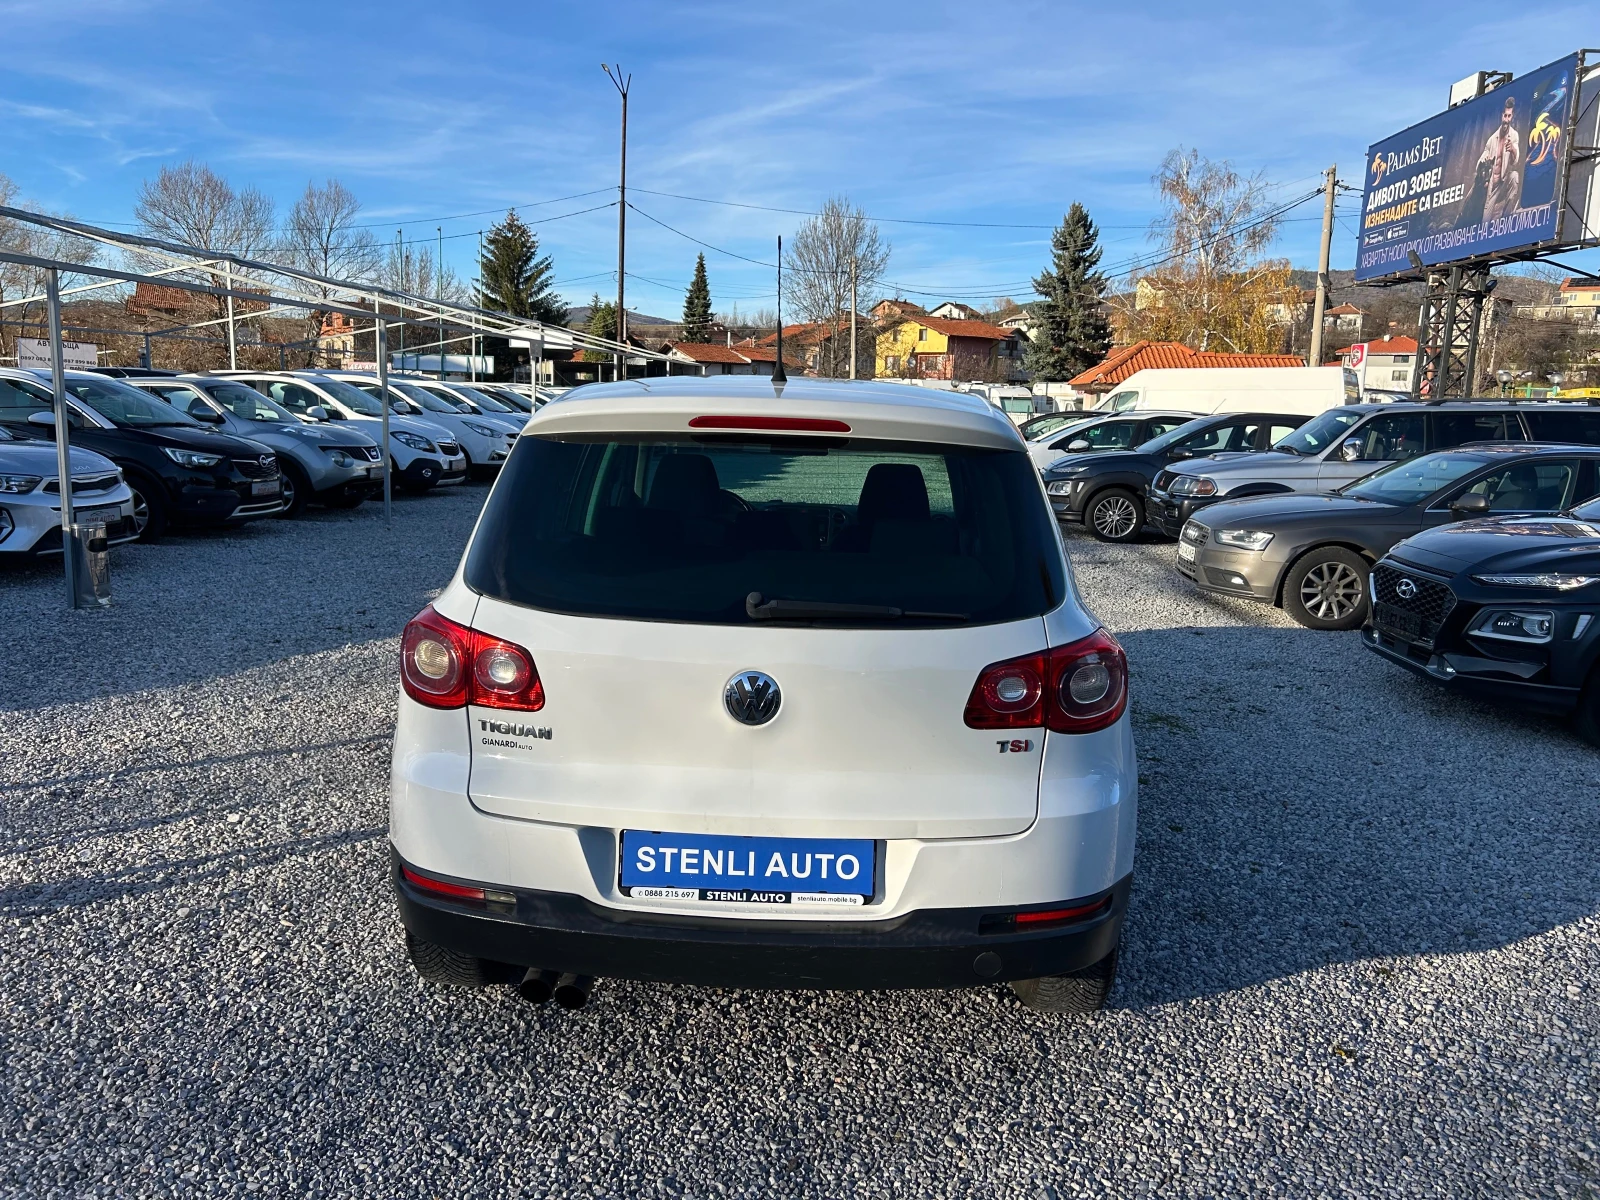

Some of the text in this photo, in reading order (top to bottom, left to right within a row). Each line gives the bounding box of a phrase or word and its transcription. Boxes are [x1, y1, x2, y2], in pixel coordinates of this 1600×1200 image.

[1386, 136, 1443, 176] PALMS BET
[1366, 167, 1442, 212] ДИВОТО ЗОВЕ!
[1365, 184, 1465, 229] ИЗНЕНАДИТЕ СА ЕХЕЕЕ!
[1424, 235, 1435, 252] ОТ
[1434, 224, 1478, 250] РАЗВИВАНЕ
[1476, 221, 1488, 241] НА
[1488, 205, 1551, 238] ЗАВИСИМОСТ!
[37, 340, 80, 350] АВТЪЩА
[478, 718, 553, 740] TIGUAN
[482, 737, 518, 748] GIANARDI
[996, 739, 1030, 754] TSI
[636, 846, 860, 880] STENLI AUTO
[644, 889, 663, 897] 0888
[680, 891, 695, 899] 697
[706, 891, 786, 903] STENLI AUTO
